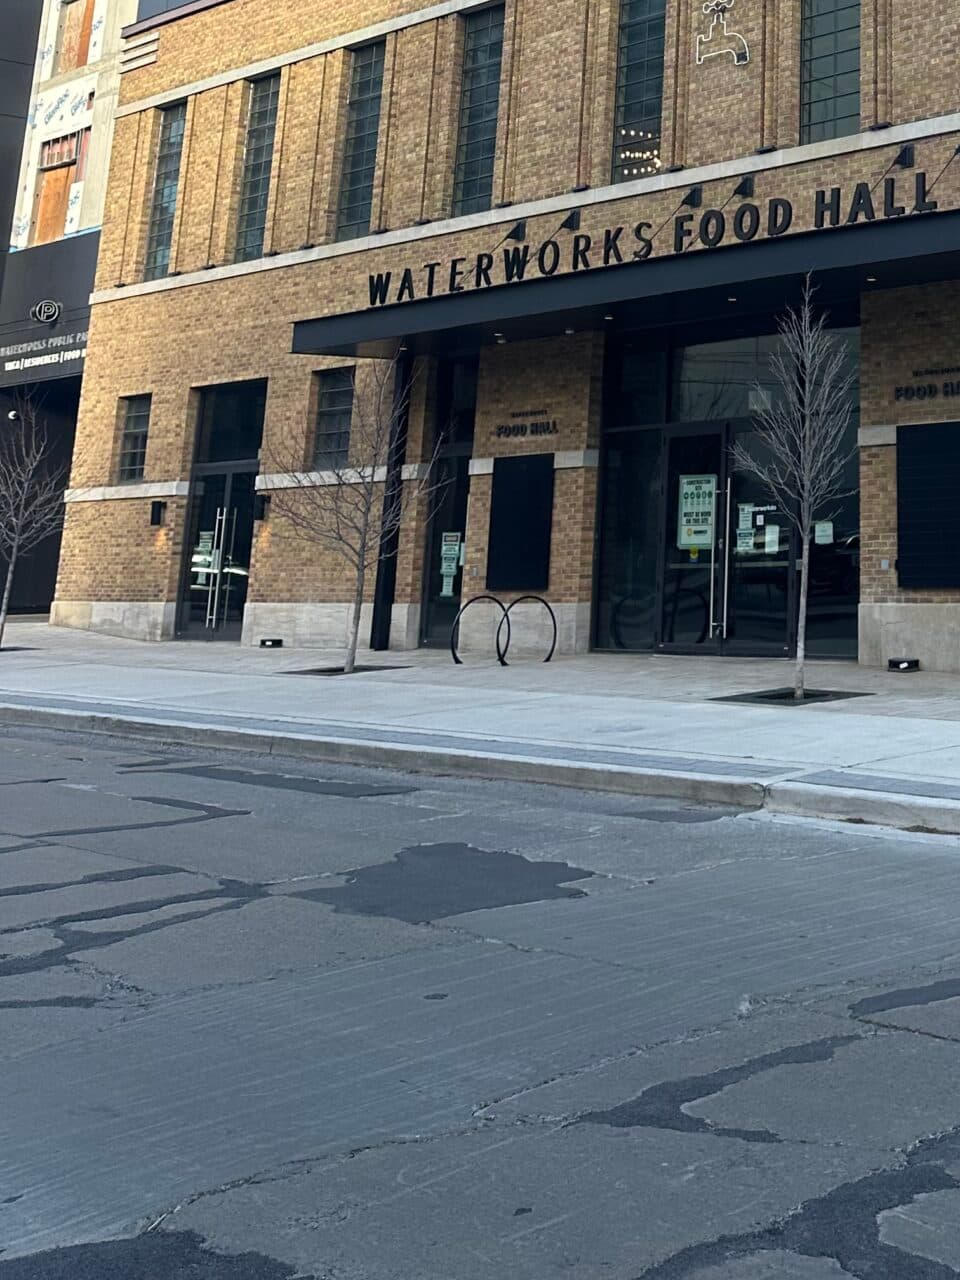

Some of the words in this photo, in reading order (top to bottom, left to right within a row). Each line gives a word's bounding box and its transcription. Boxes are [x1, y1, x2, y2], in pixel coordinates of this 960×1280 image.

[368, 222, 653, 306] WATERWORKS
[673, 198, 793, 252] FOOD
[814, 172, 938, 229] HALL
[76, 332, 88, 342] PA
[895, 384, 938, 400] FOOD
[496, 424, 528, 438] FOOD
[530, 420, 560, 436] HALL
